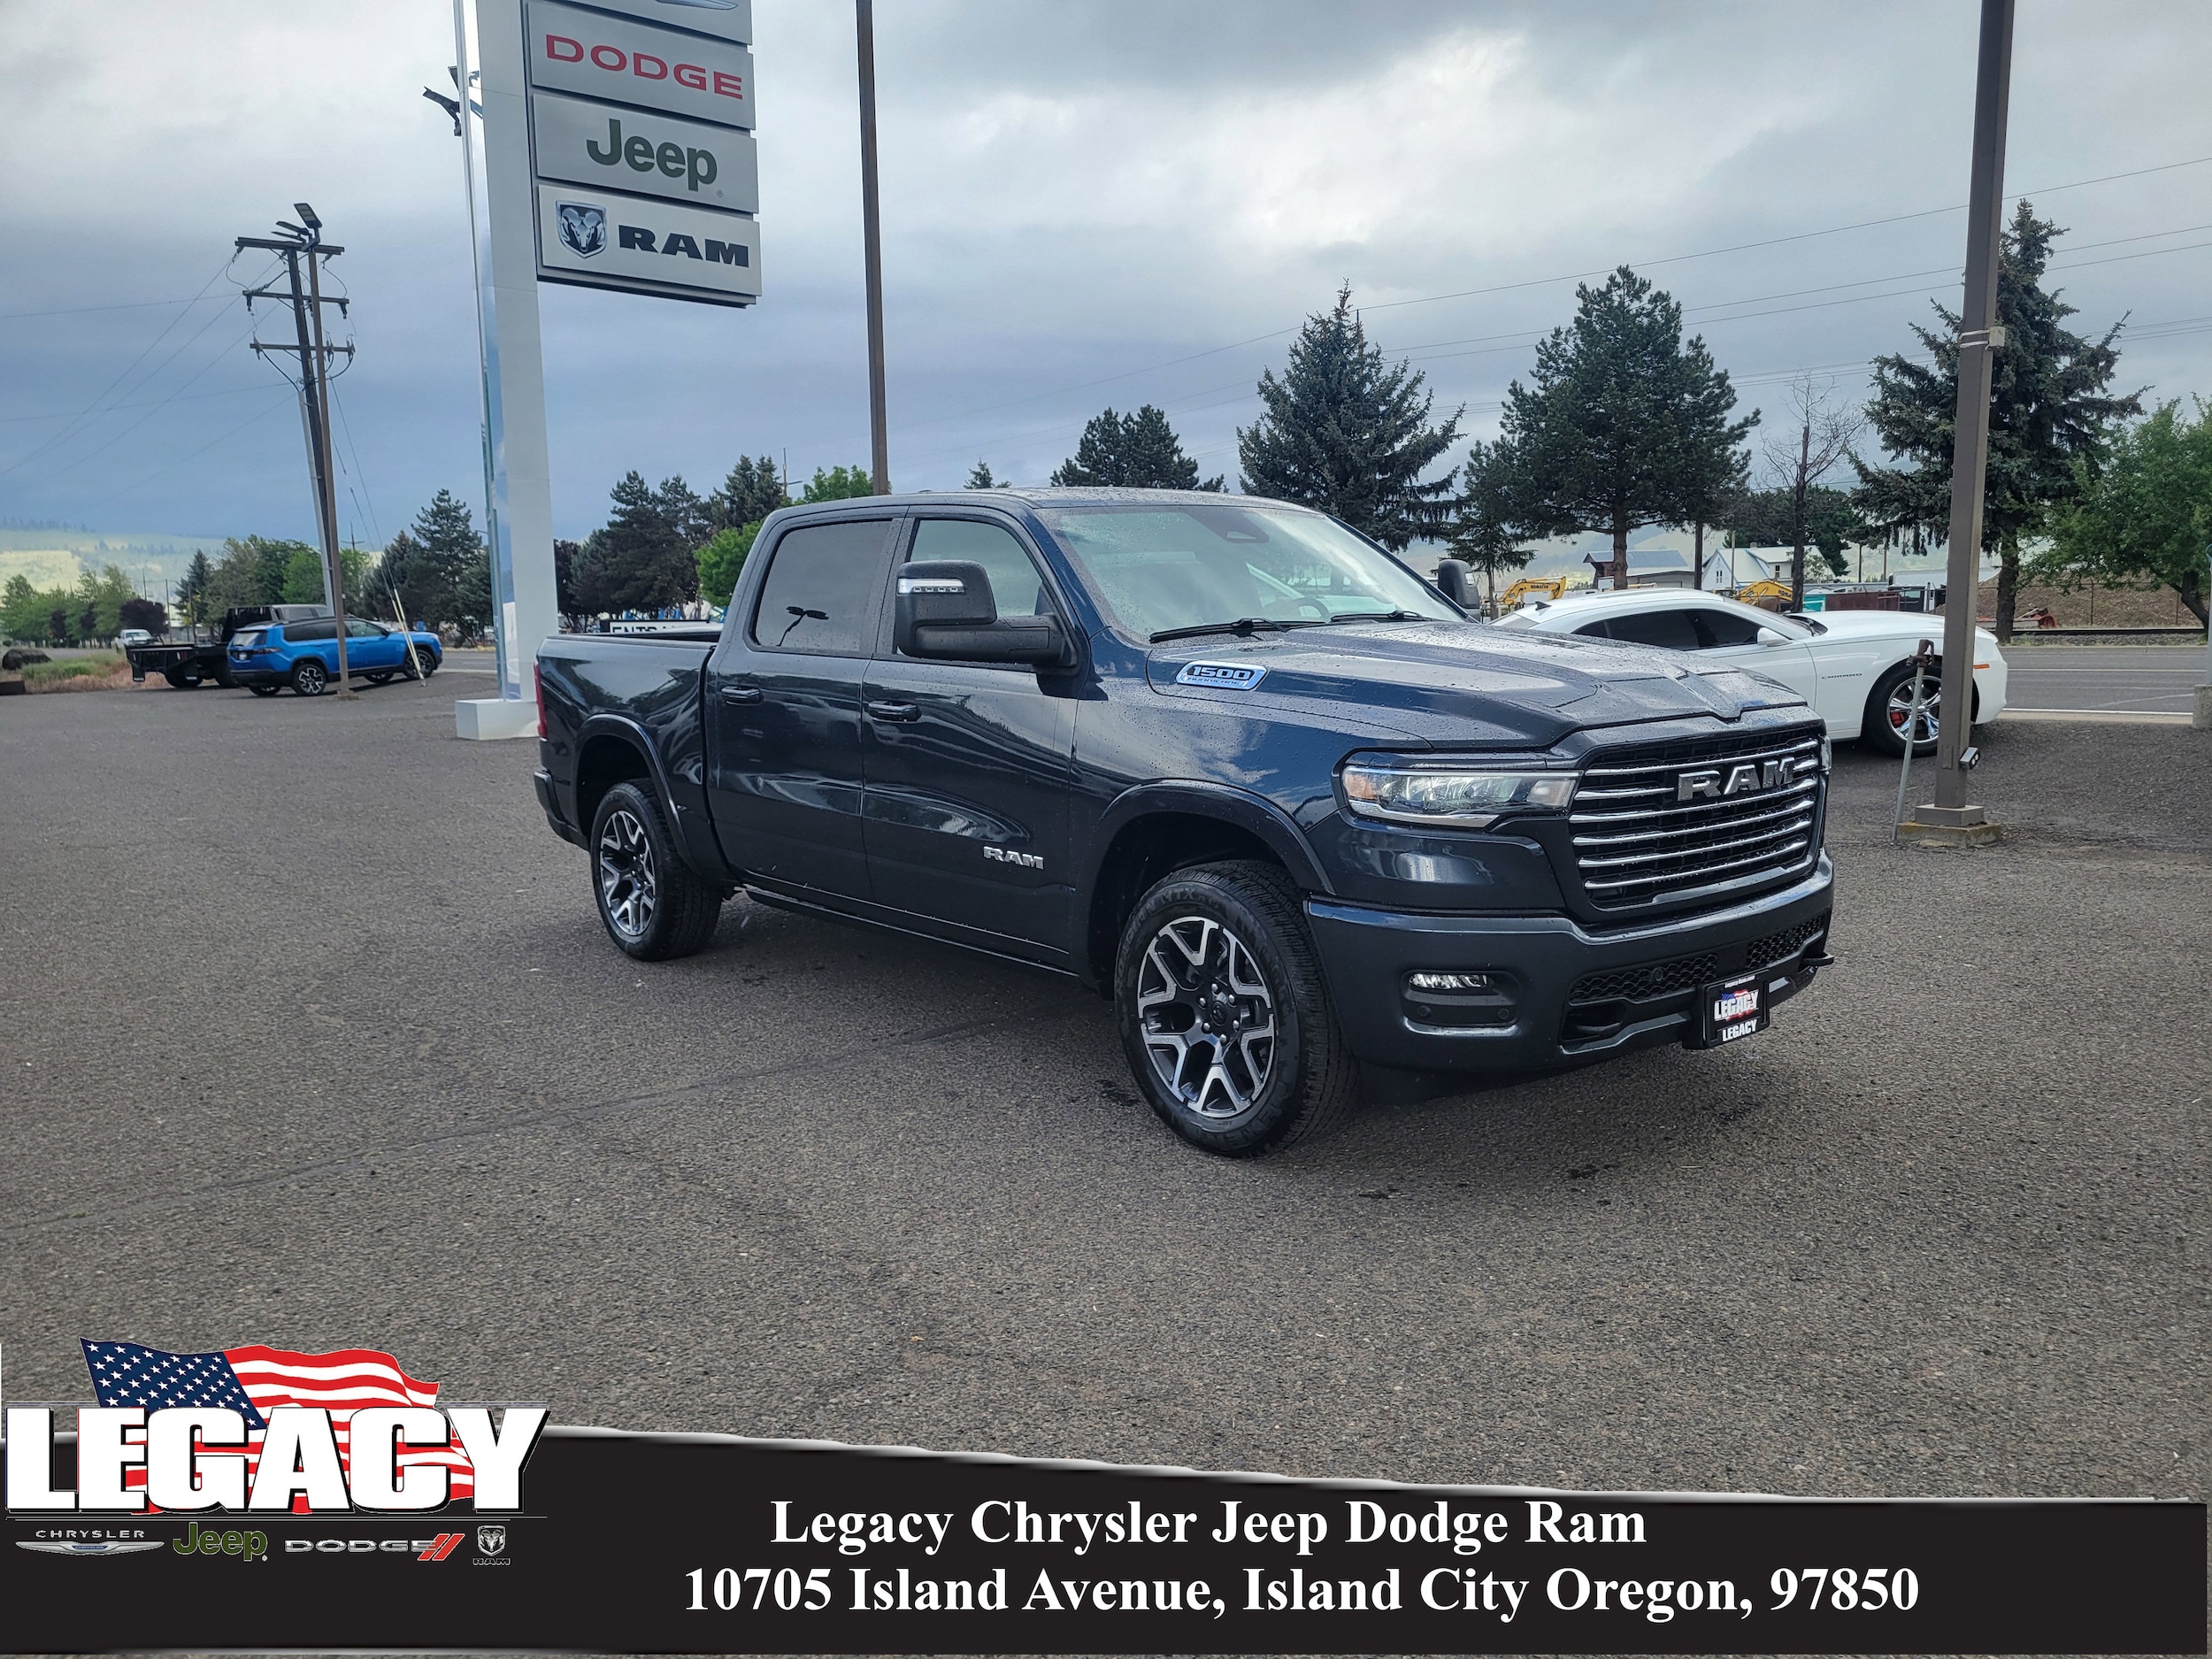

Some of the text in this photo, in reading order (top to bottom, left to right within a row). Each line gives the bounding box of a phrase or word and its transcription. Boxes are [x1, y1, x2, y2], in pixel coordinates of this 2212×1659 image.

[546, 34, 743, 100] DODGE
[586, 118, 718, 192] Jeep
[618, 224, 749, 268] RAM
[1194, 666, 1251, 680] 1500
[1678, 757, 1795, 802] RAM
[983, 846, 1044, 870] RAM
[1714, 990, 1759, 1020] LEGACY
[1722, 1018, 1757, 1041] LEGACY
